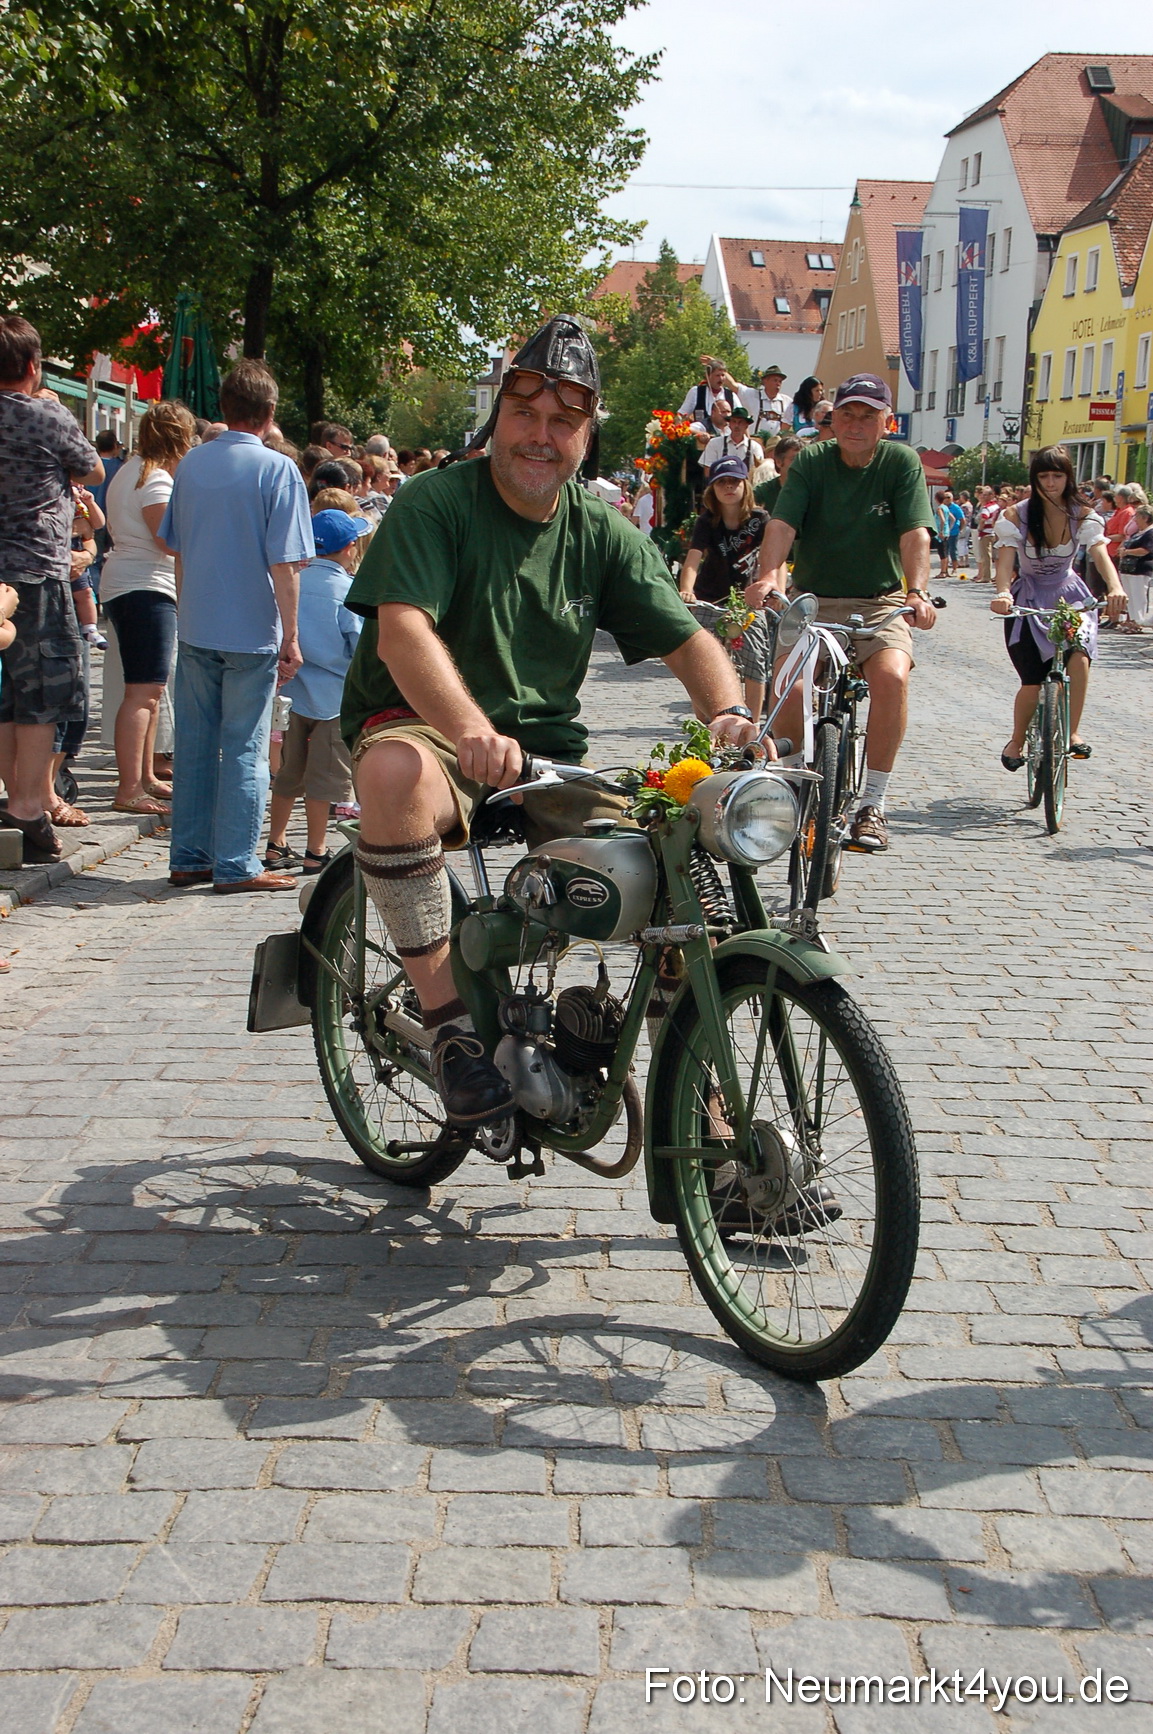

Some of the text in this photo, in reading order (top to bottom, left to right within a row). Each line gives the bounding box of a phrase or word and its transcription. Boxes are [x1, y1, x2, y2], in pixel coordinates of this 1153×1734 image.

[968, 276, 979, 363] K&L RUPPERT
[1072, 318, 1094, 340] HOTEL
[1062, 421, 1094, 435] Restaurant
